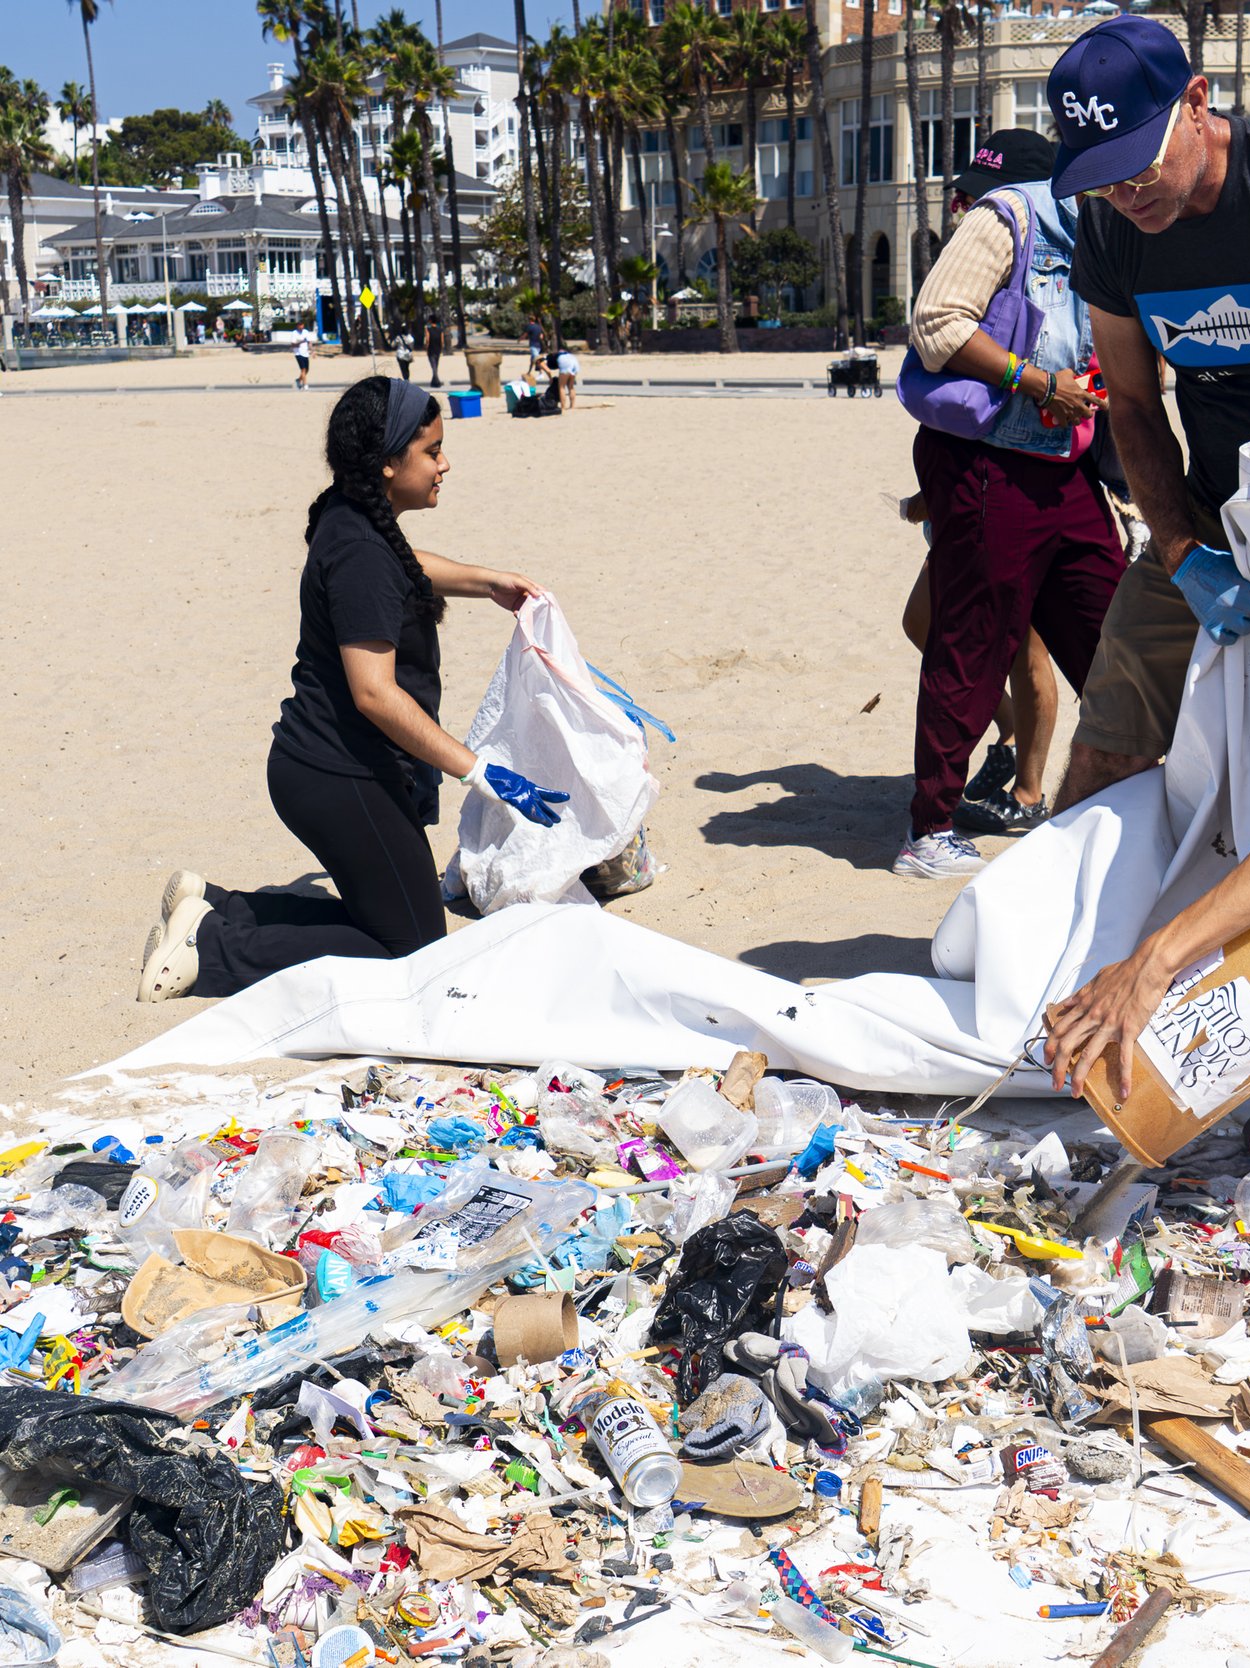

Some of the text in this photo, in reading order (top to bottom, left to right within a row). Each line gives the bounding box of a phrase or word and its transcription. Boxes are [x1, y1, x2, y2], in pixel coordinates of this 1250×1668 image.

[1062, 91, 1118, 130] SMC
[1155, 1013, 1211, 1088] SANT
[124, 1186, 147, 1219] Kettle
[131, 1193, 150, 1217] corn
[594, 1402, 645, 1440] Modelo
[614, 1432, 652, 1457] Especial
